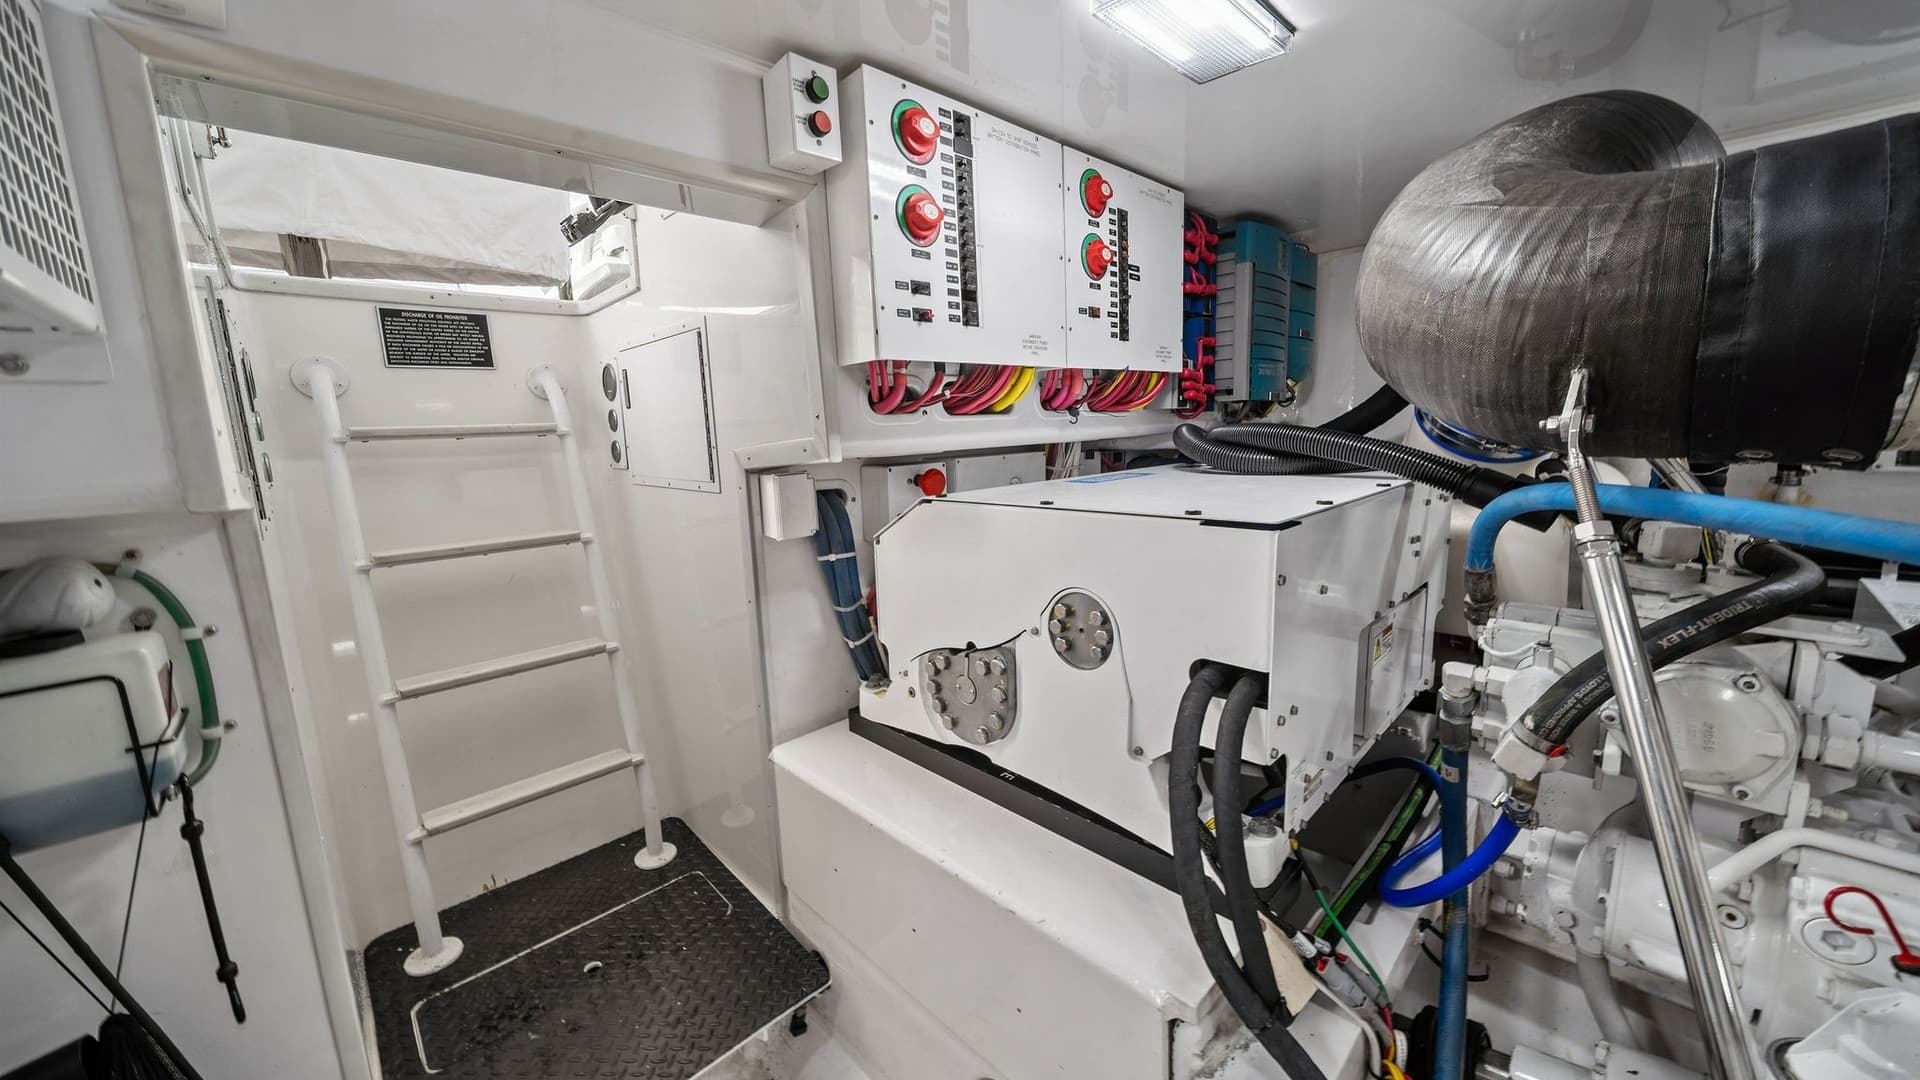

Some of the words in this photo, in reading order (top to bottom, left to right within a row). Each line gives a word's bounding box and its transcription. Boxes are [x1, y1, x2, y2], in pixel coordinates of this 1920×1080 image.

[401, 311, 426, 319] DISCHARGE
[1655, 599, 1754, 650] TRIDENT-FLEX
[1545, 697, 1578, 730] APPROVED
